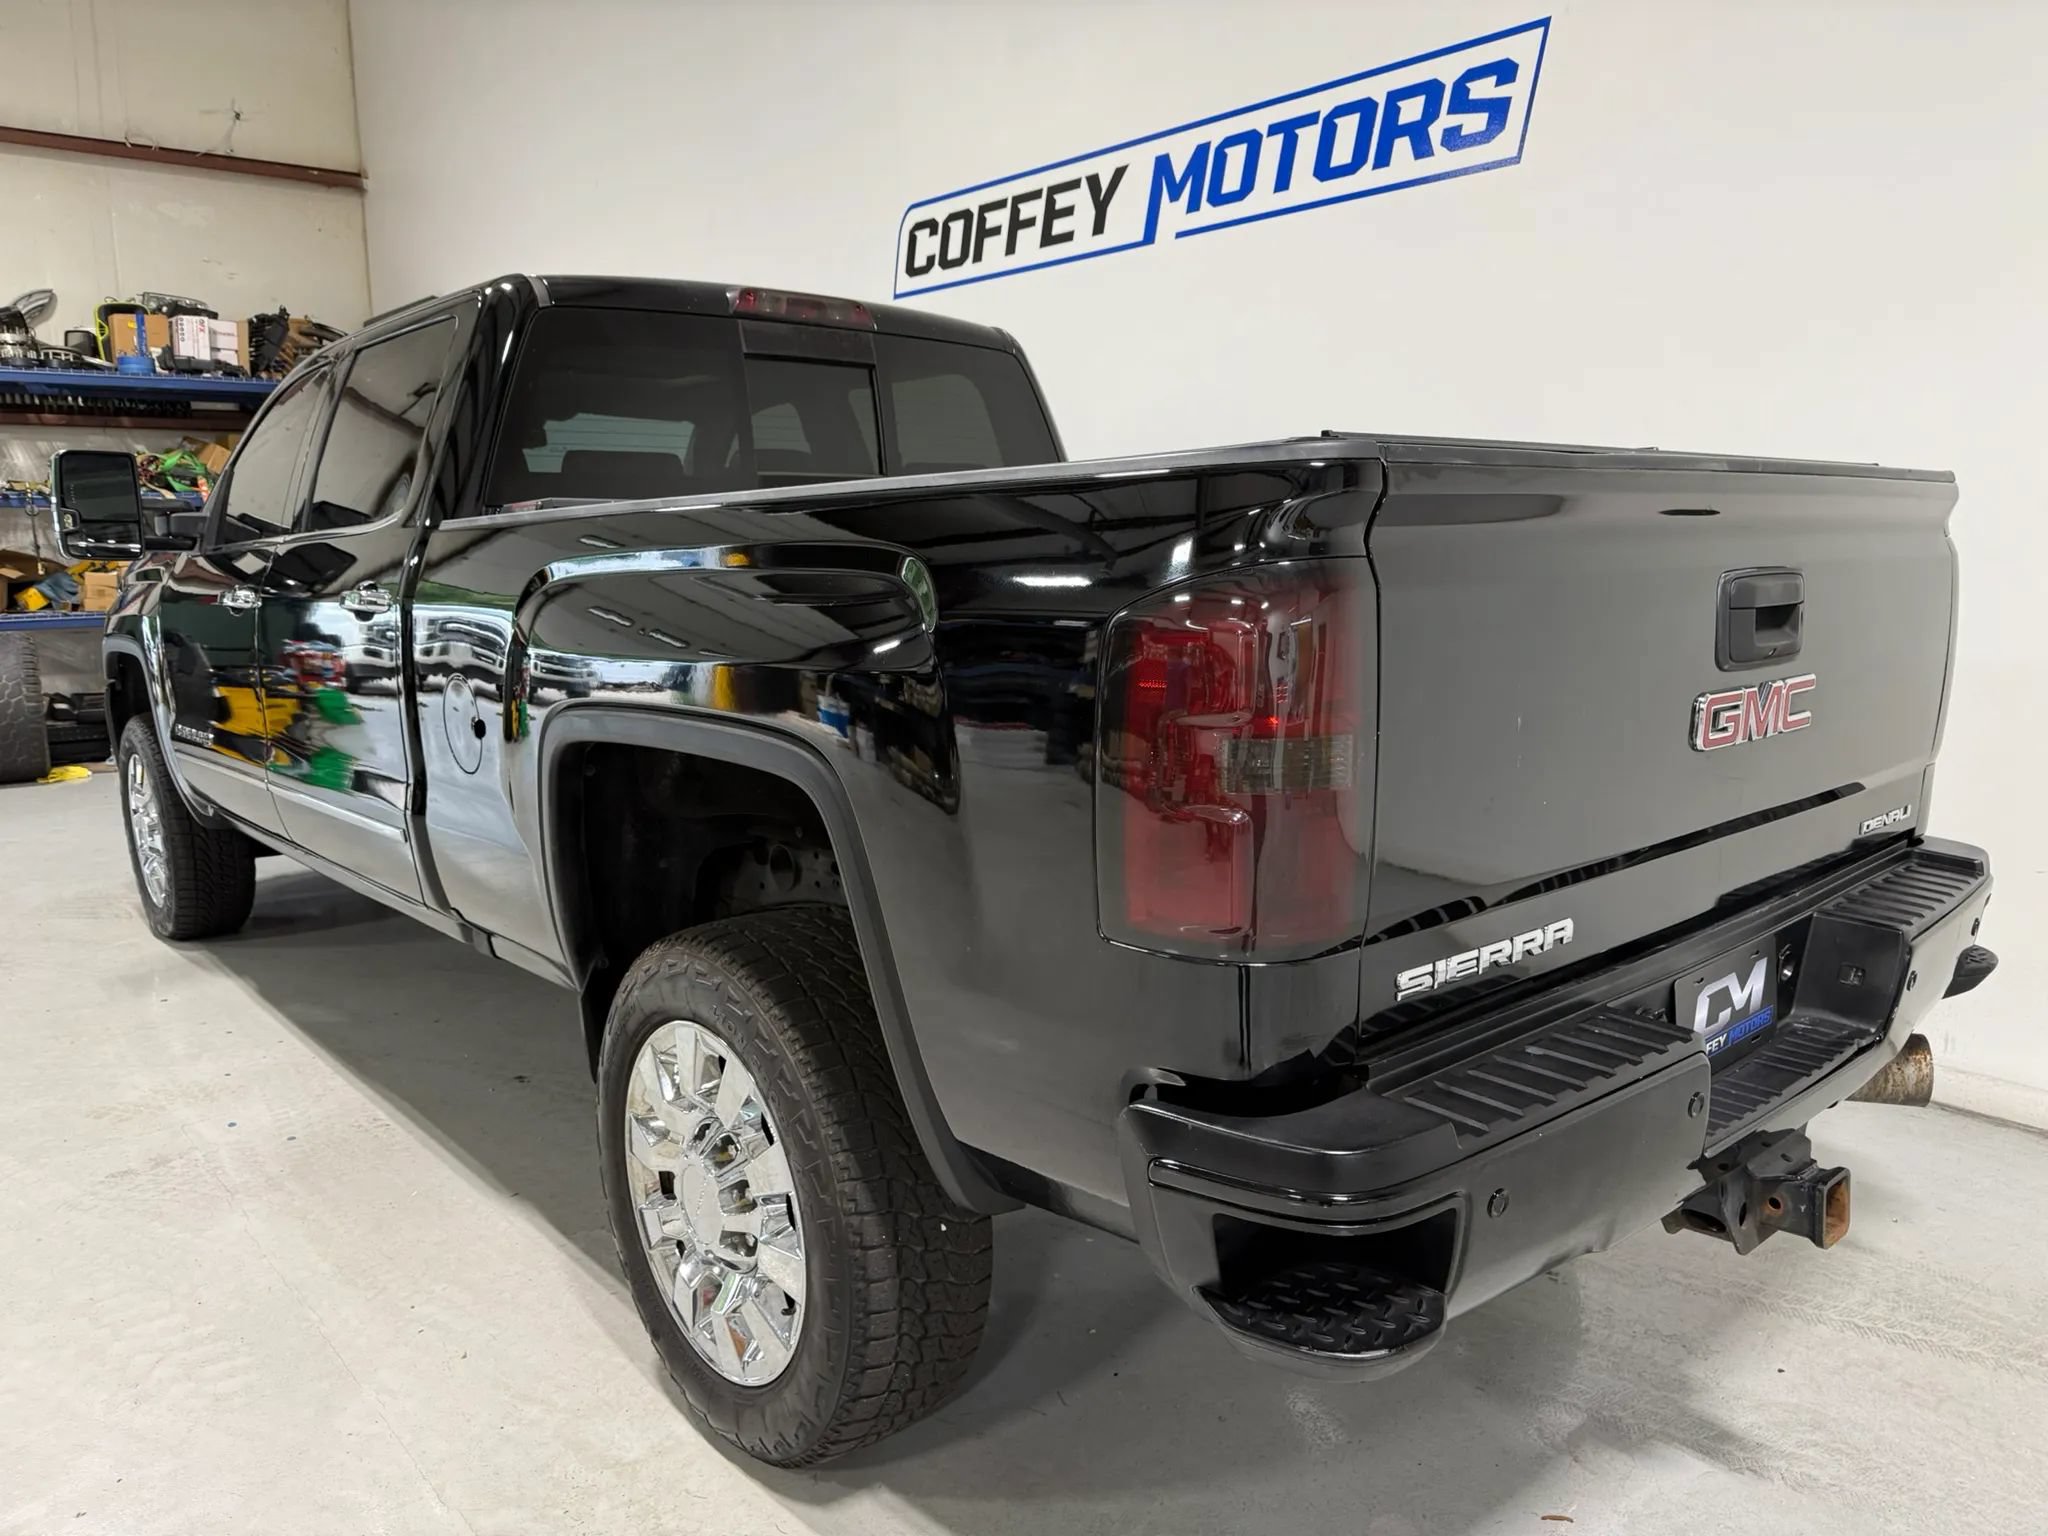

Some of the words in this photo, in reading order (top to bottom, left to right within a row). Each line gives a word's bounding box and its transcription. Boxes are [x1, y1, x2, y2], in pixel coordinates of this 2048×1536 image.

[905, 164, 1129, 278] COFFEY
[1143, 57, 1519, 245] MOTORS
[1693, 673, 1816, 751] GMC
[1861, 804, 1911, 835] DENALI
[1396, 917, 1574, 1001] SIERRA
[1693, 957, 1767, 1037] CM
[1729, 1009, 1771, 1045] MOTORS
